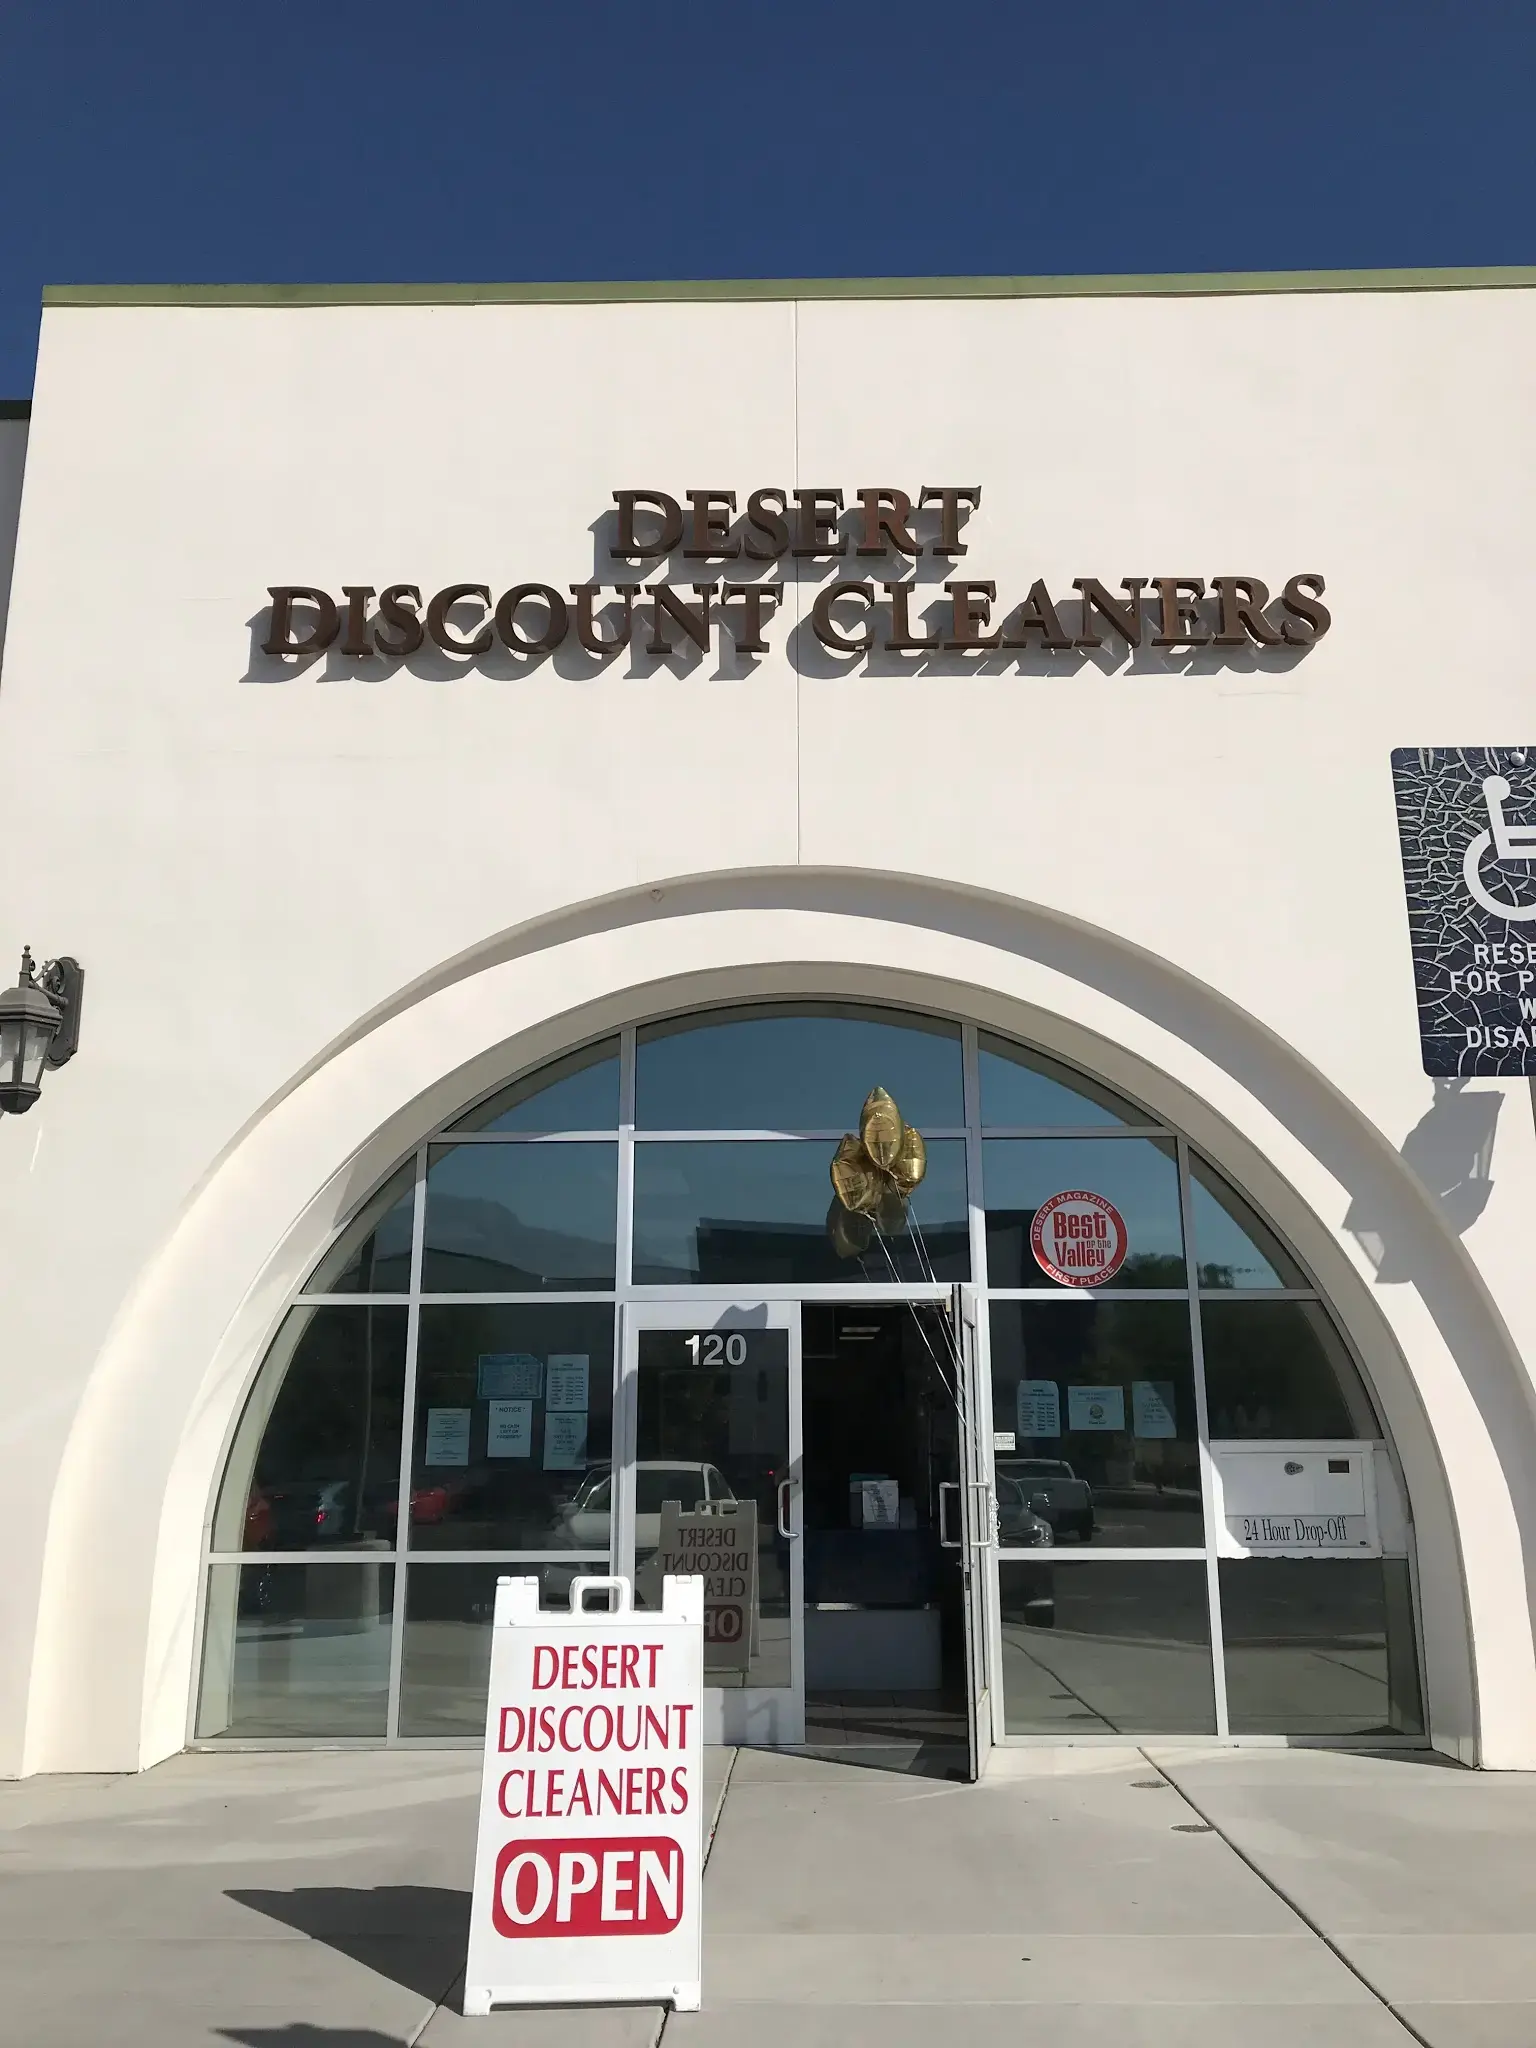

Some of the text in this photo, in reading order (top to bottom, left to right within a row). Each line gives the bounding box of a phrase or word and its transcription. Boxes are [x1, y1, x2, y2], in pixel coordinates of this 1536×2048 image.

[610, 485, 981, 560] DESERT
[261, 574, 1331, 656] DISCOUNT CLEANERS
[1450, 971, 1501, 992] FOR
[1033, 1192, 1114, 1241] DESERT MAGAZINE
[1053, 1211, 1107, 1239] Best
[1054, 1241, 1106, 1267] Valley
[1097, 1239, 1112, 1248] the
[1046, 1263, 1115, 1285] FIRST PLACE
[685, 1334, 747, 1366] 120
[1244, 1516, 1348, 1547] 24 Hour Drop-Off
[532, 1644, 664, 1690] DESERT
[498, 1704, 694, 1754] DISCOUNT
[498, 1766, 689, 1819] CLEANERS
[500, 1850, 678, 1926] OPEN
